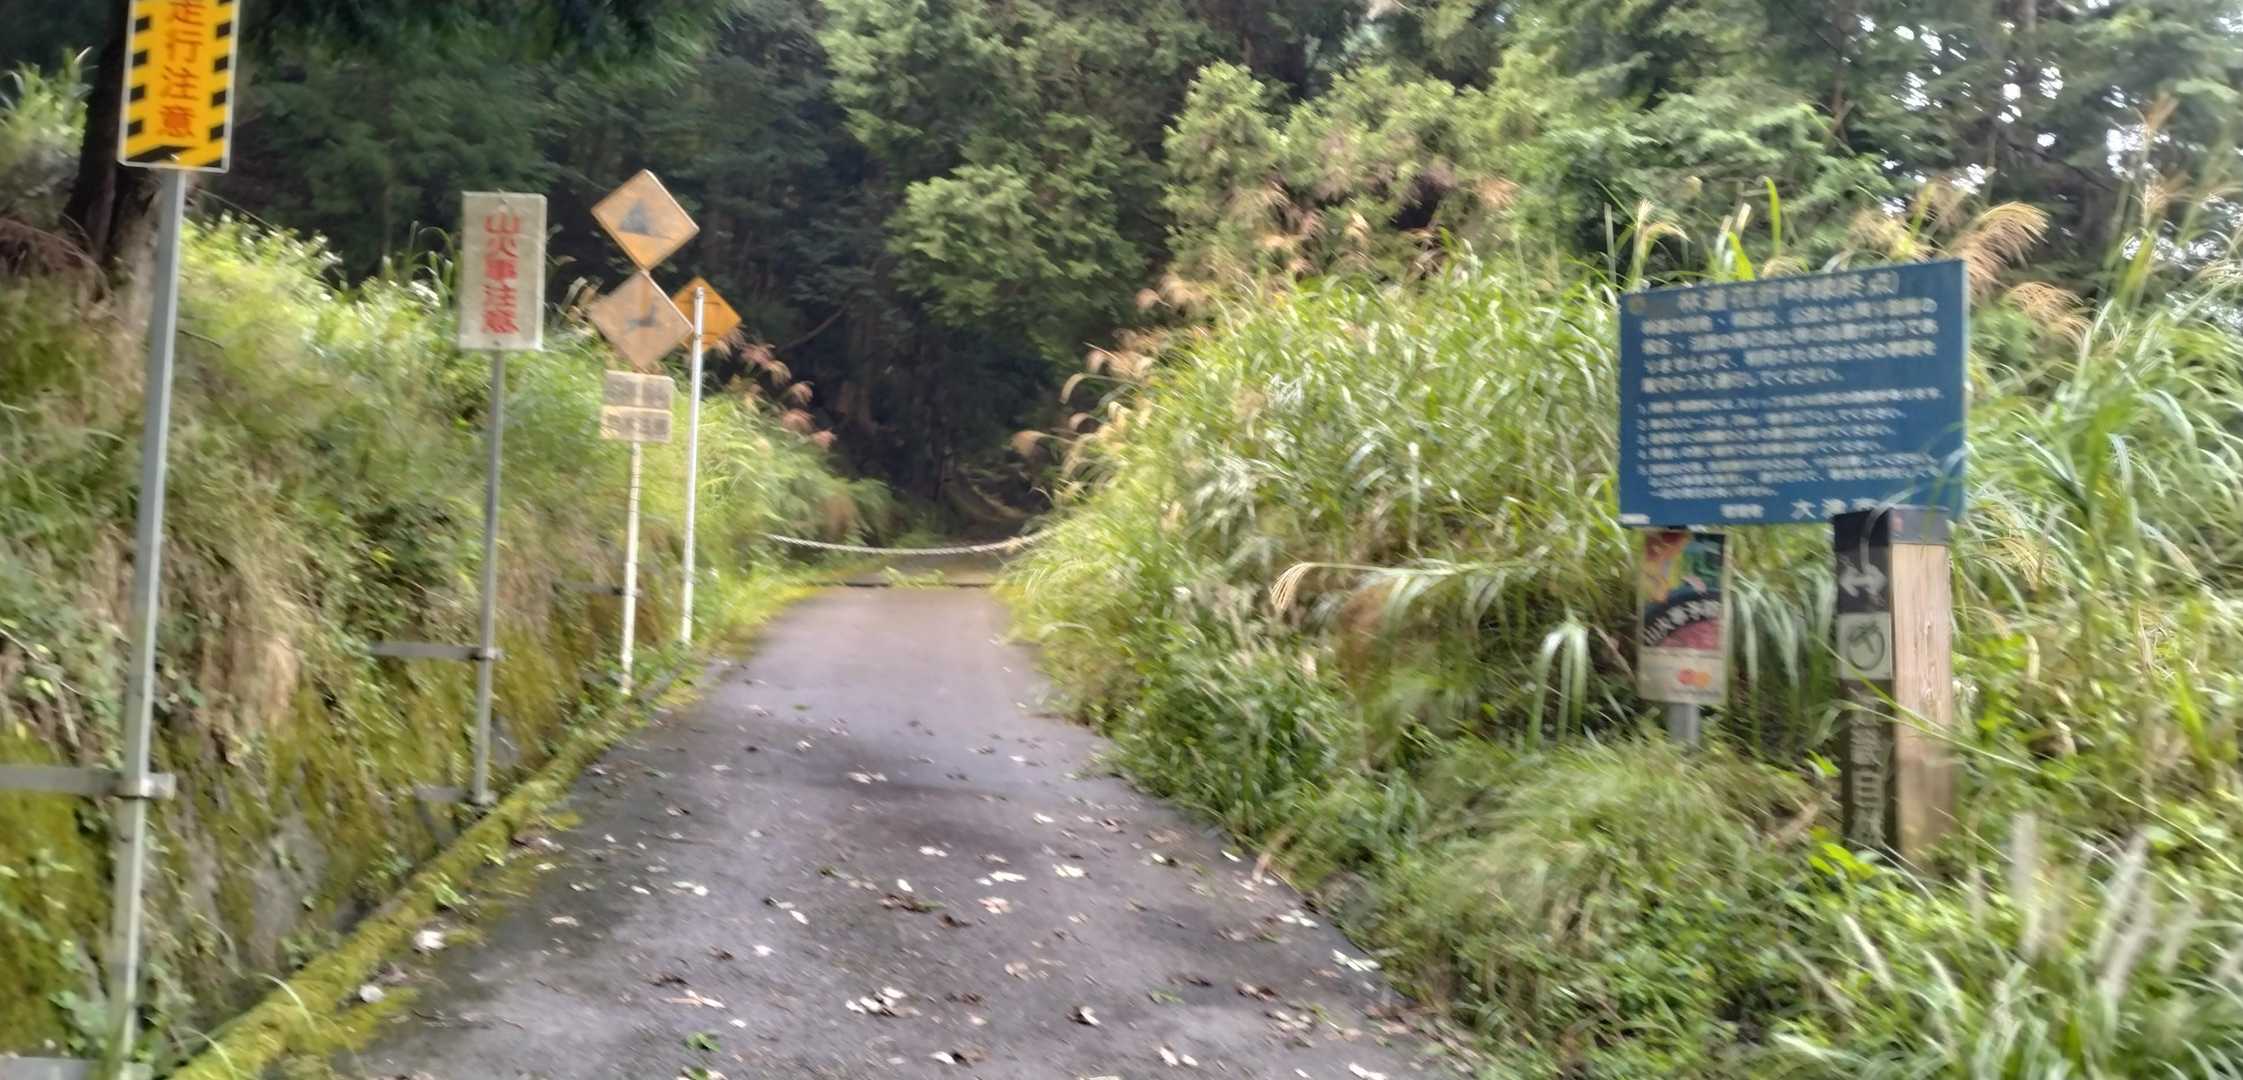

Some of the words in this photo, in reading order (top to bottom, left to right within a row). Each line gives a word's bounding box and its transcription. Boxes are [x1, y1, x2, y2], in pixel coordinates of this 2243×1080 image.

[158, 0, 207, 138] 走行注意
[481, 211, 522, 335] 山火事注意
